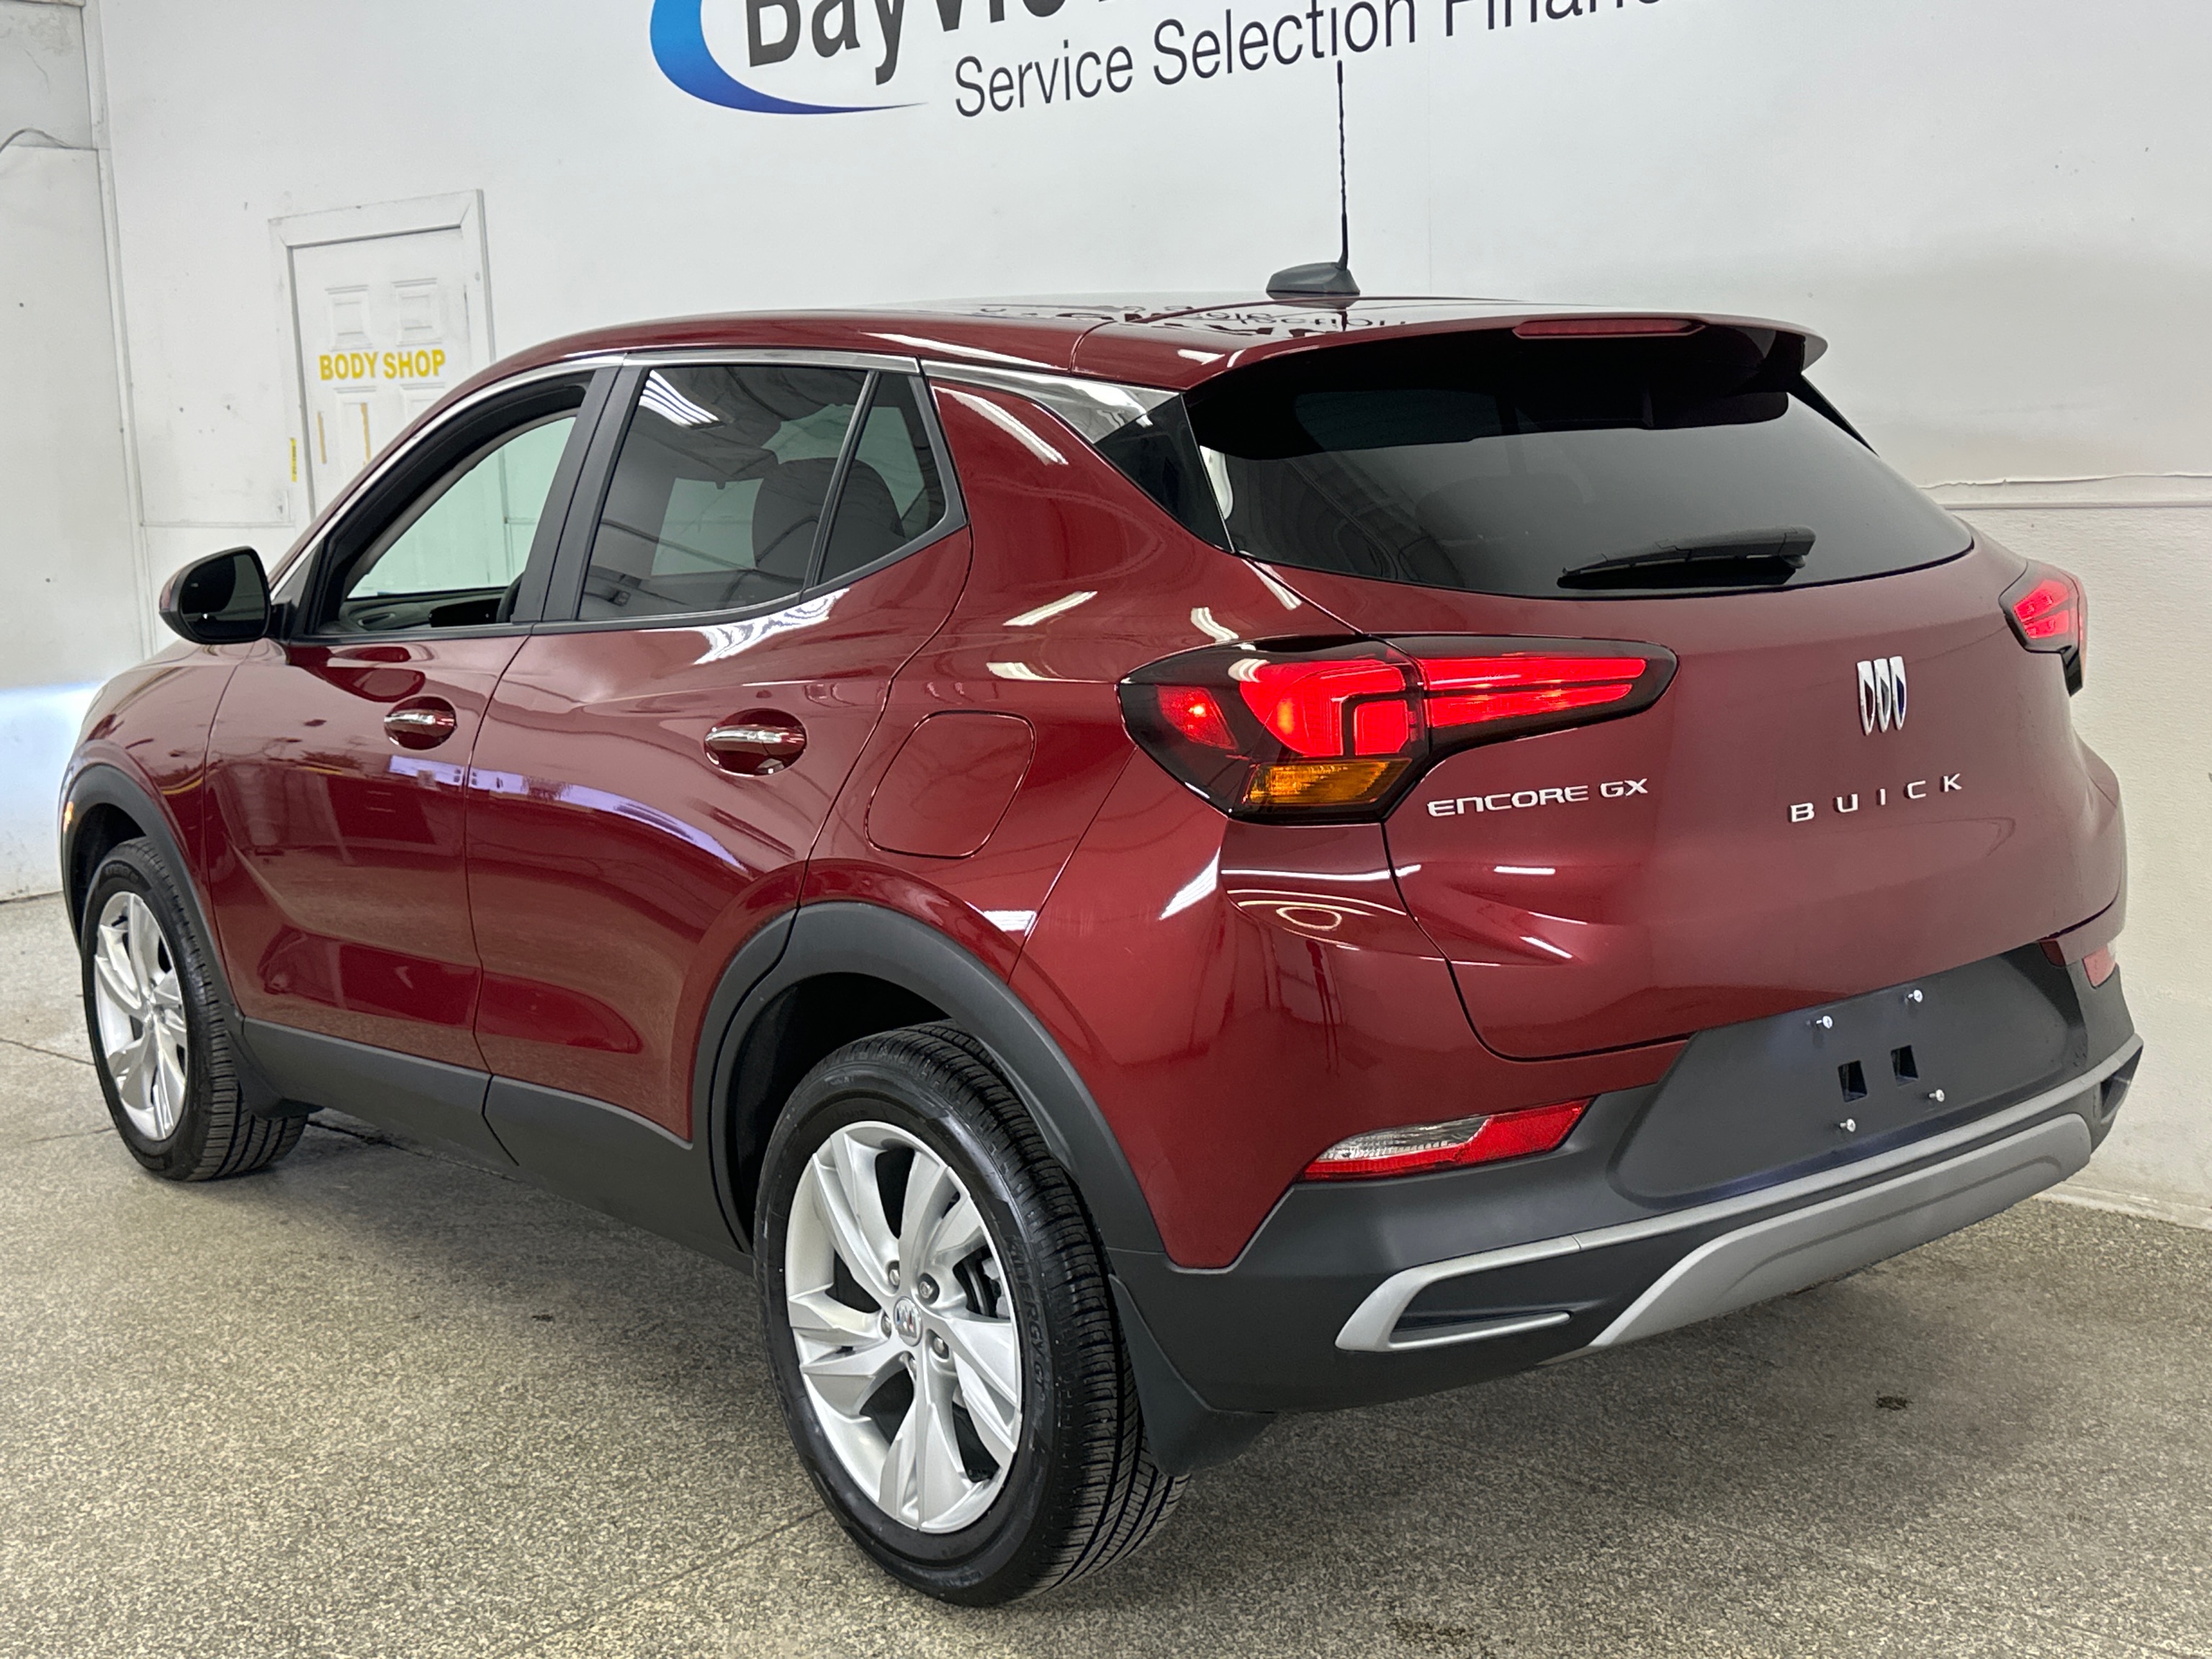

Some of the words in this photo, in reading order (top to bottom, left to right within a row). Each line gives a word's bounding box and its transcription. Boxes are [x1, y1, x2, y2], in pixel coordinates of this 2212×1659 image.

[955, 40, 1134, 117] Service
[1153, 0, 1416, 86] Selection
[318, 352, 377, 381] BODY
[383, 349, 446, 379] SHOP
[1426, 785, 1589, 817] ENCORE
[1600, 778, 1649, 799] GX
[1789, 773, 1963, 823] BUICK
